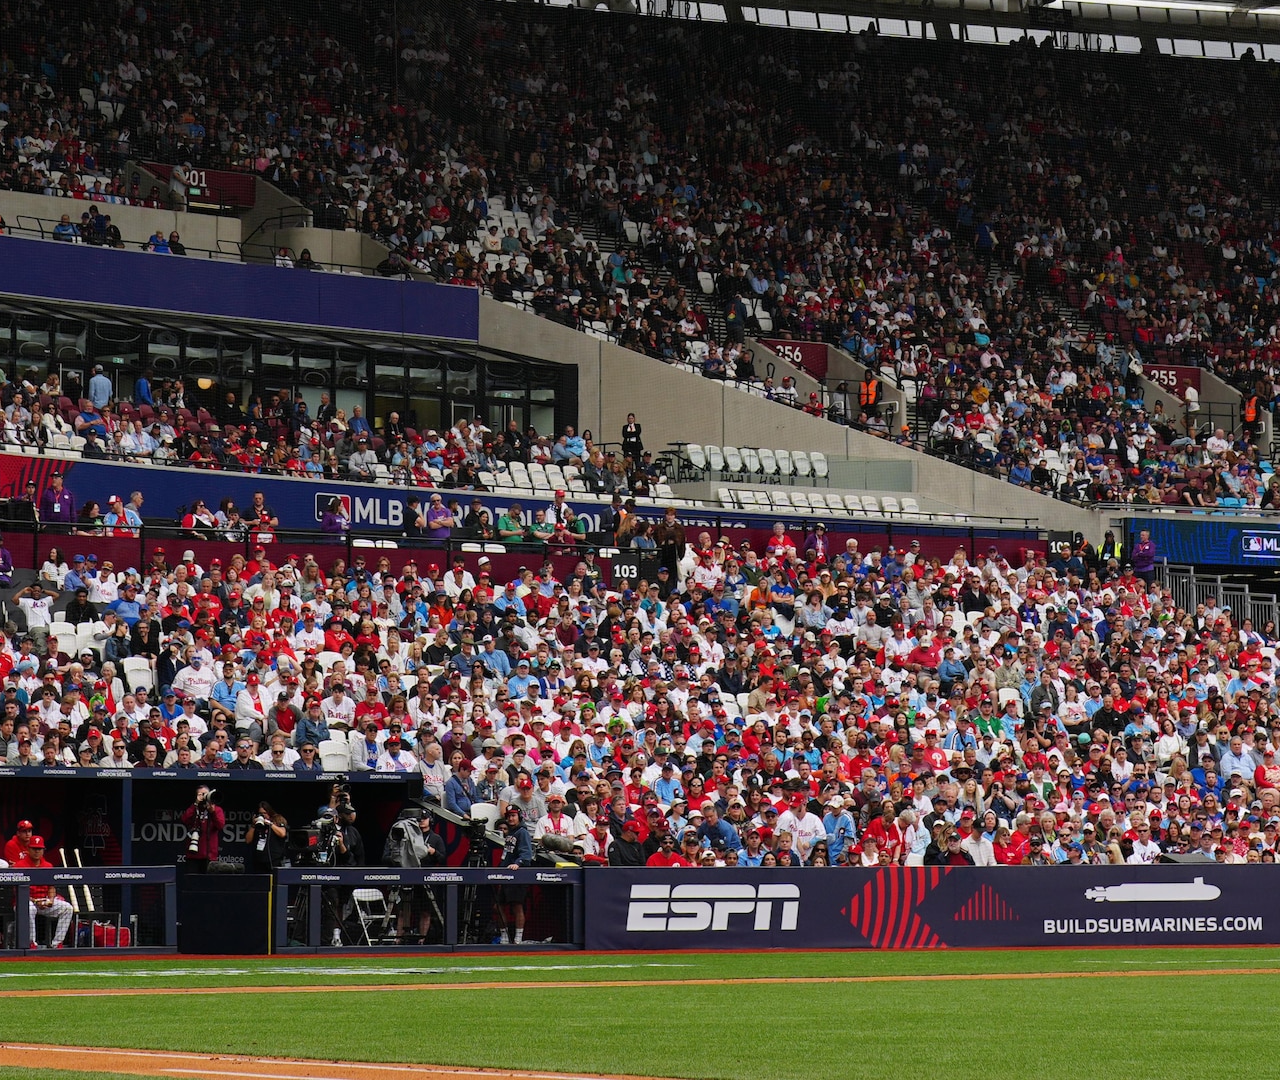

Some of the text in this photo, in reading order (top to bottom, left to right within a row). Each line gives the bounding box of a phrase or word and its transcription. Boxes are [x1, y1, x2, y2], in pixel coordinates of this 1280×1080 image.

[776, 345, 802, 362] 256
[1150, 370, 1177, 386] 255
[354, 496, 403, 526] MLB
[613, 565, 637, 578] 103
[130, 823, 186, 842] LOND
[626, 884, 801, 932] ESPN
[1043, 916, 1263, 934] BUILDSUBMARINES.COM
